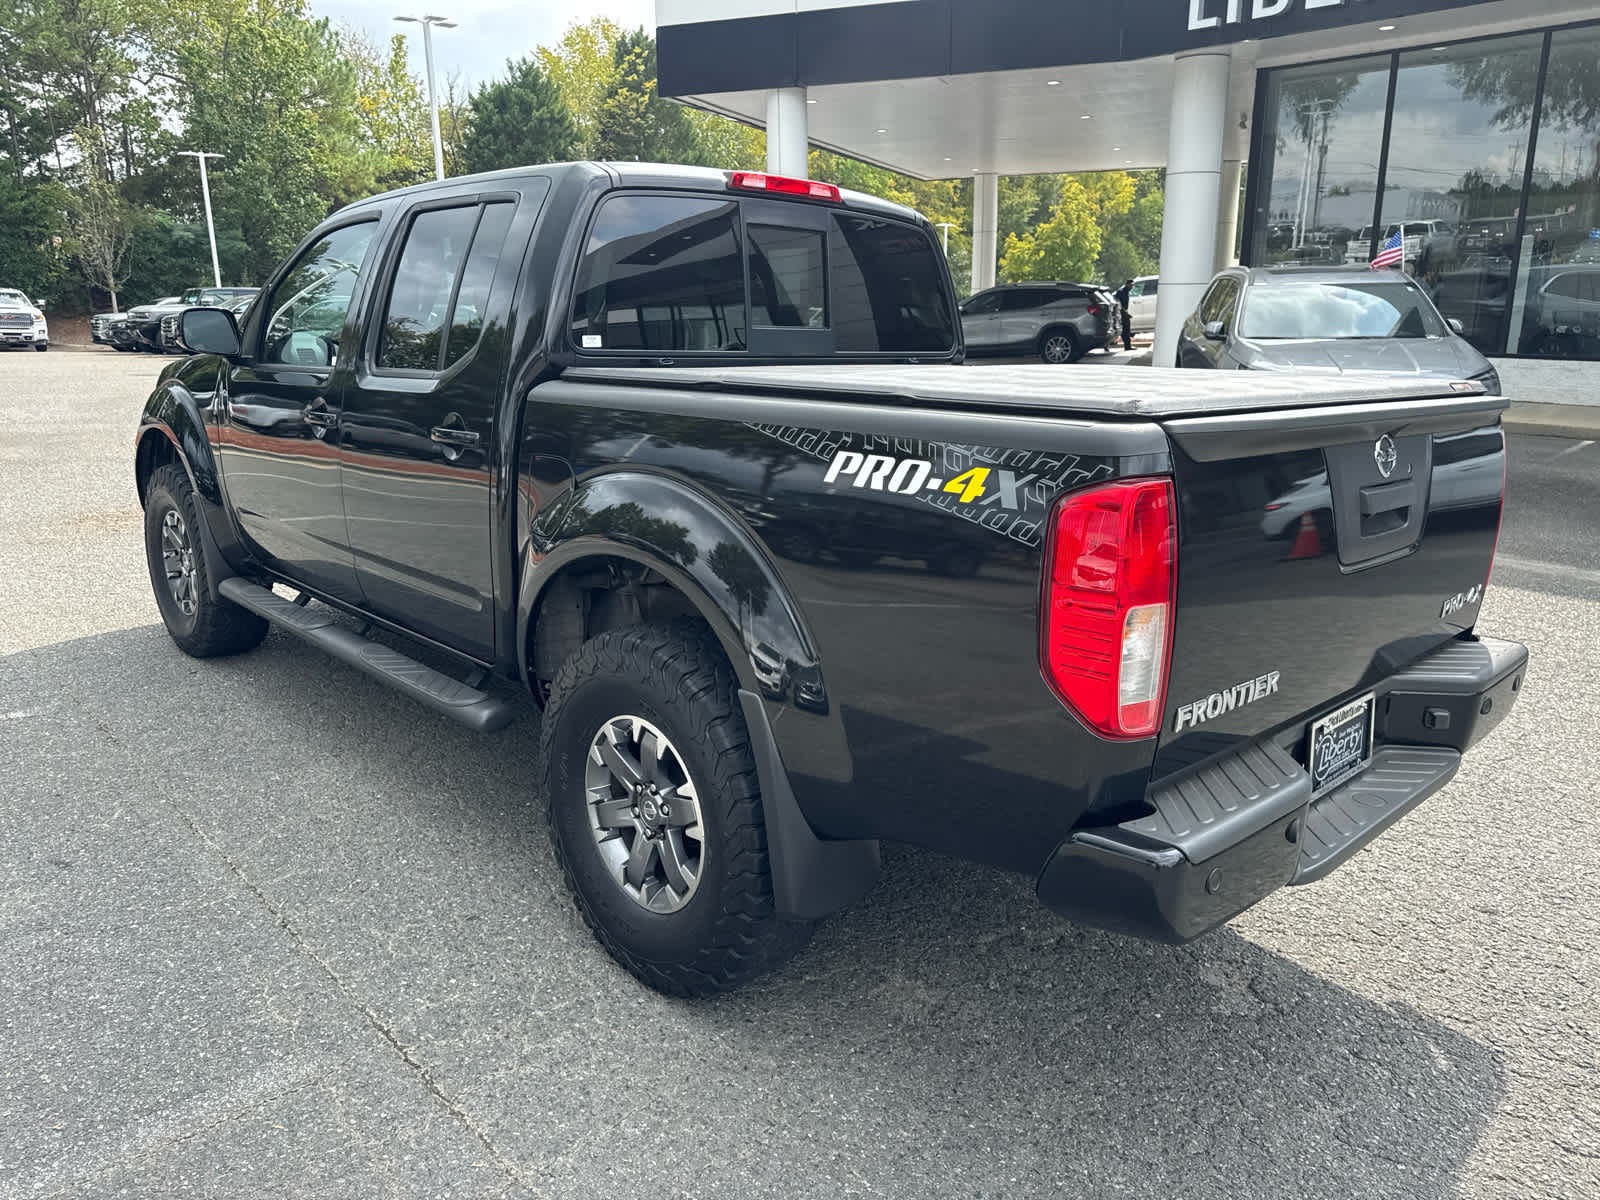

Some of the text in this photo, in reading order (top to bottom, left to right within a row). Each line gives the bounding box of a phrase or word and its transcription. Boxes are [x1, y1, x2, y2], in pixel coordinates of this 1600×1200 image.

[823, 450, 1039, 510] PRO-4X
[1175, 670, 1280, 733] FRONTIER
[1318, 730, 1362, 772] Liberty
